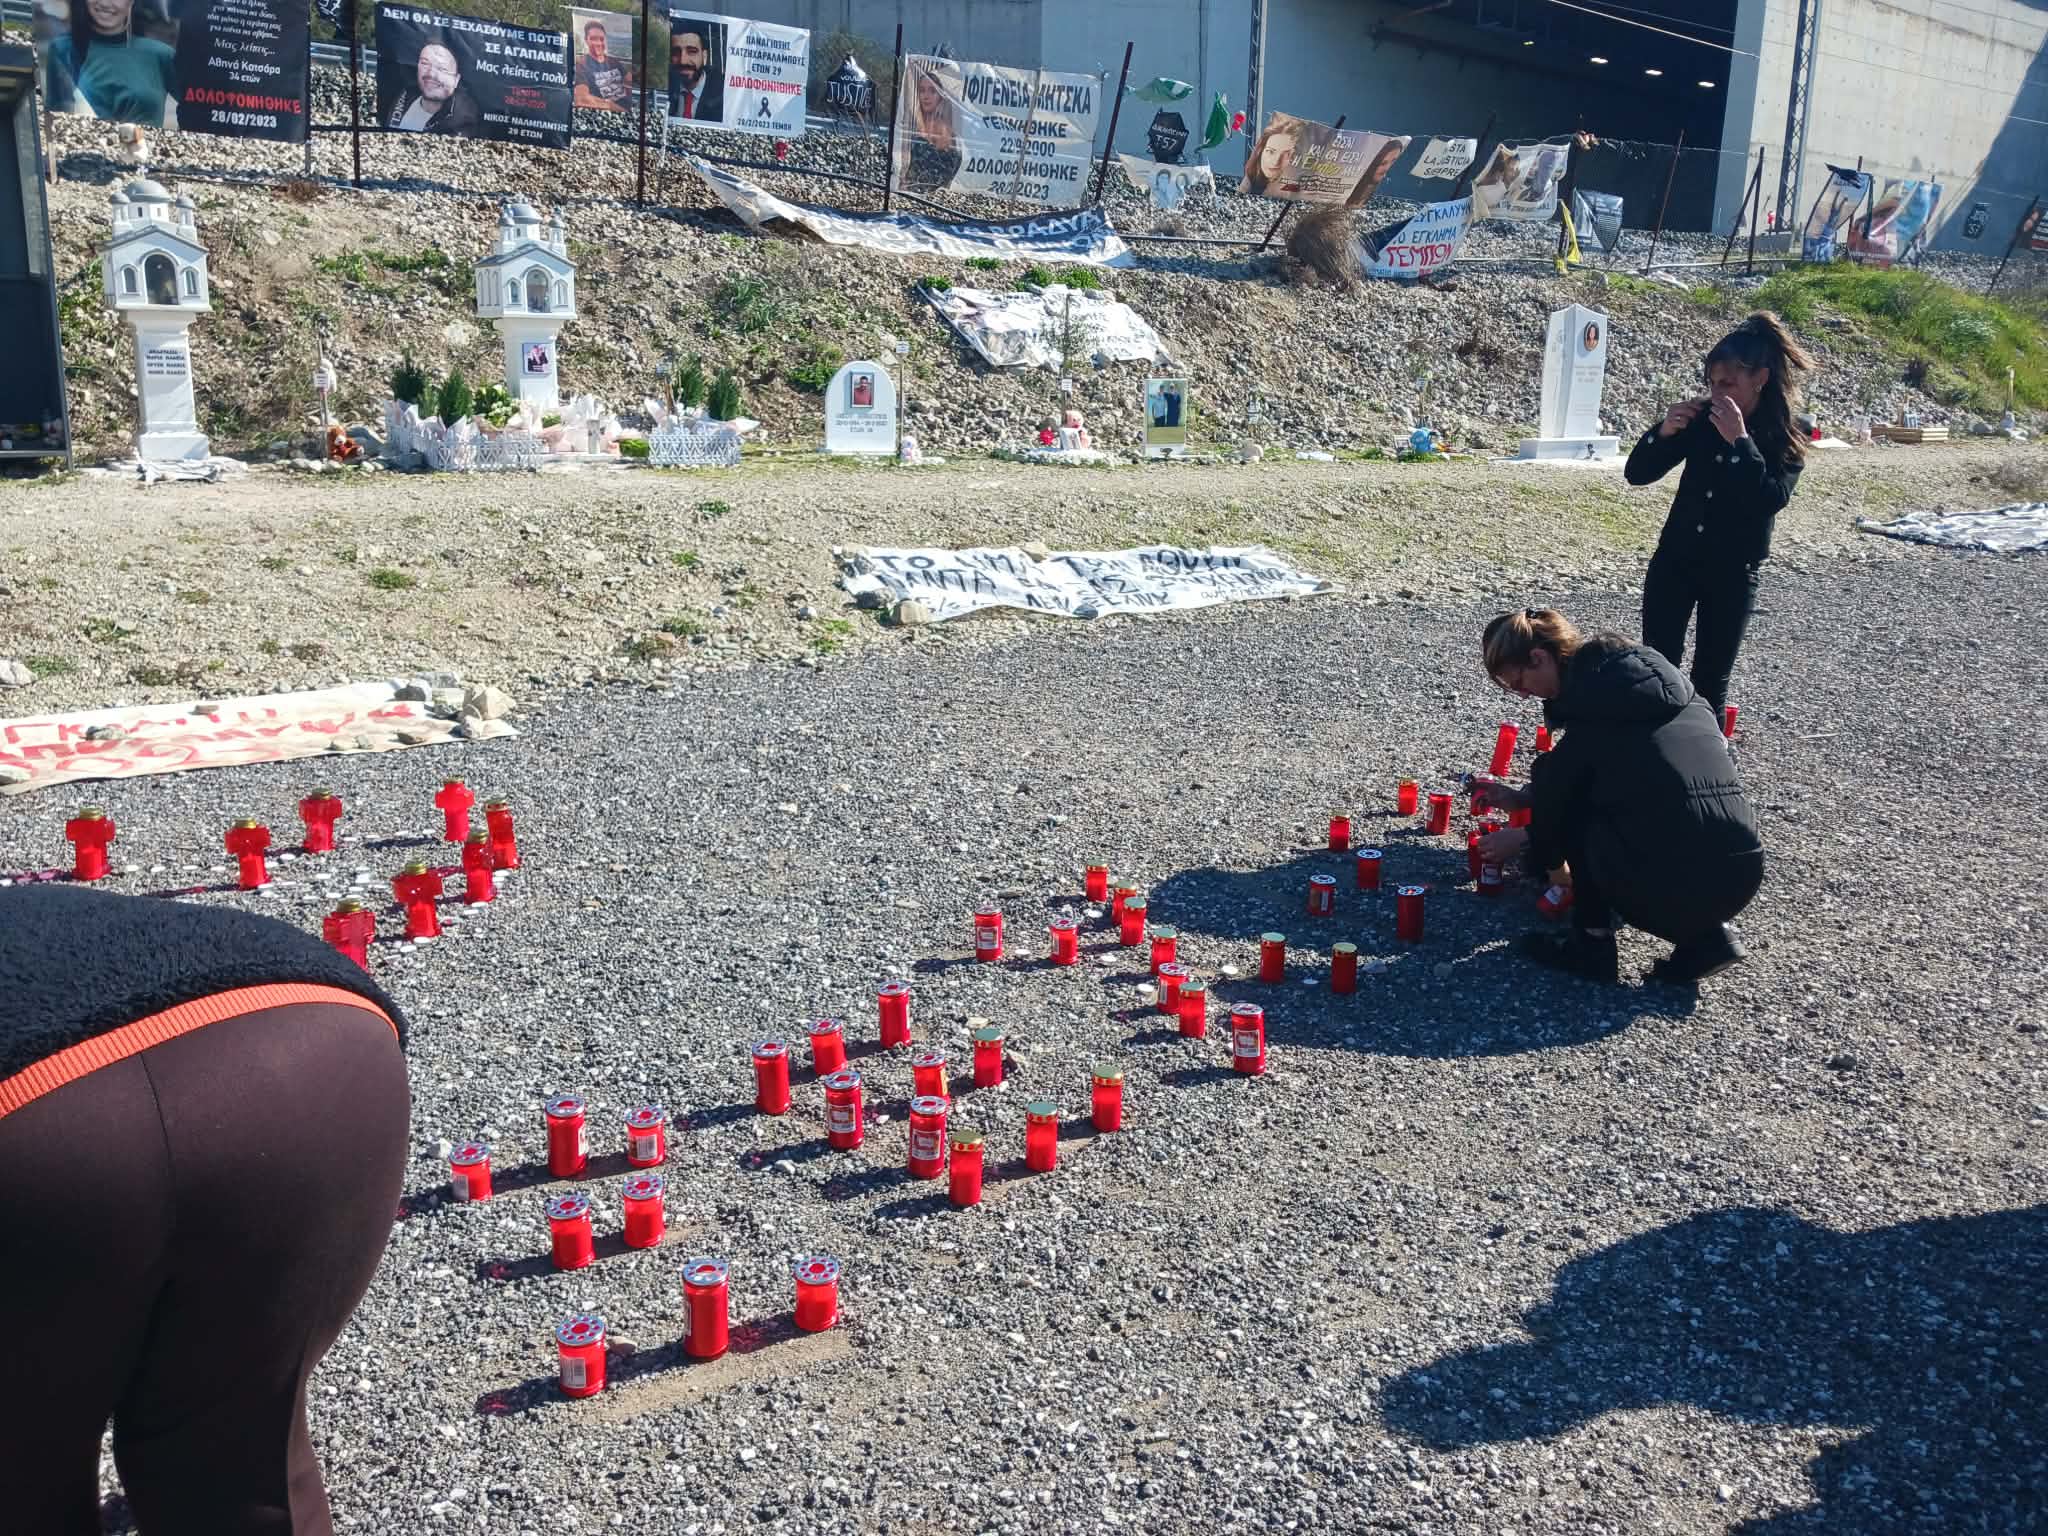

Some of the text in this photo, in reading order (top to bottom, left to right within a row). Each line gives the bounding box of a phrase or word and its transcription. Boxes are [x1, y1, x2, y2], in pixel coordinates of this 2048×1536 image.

[383, 7, 409, 21] ΔΕΝ
[412, 12, 431, 25] ΘΑ
[433, 15, 450, 28] ΣΕ
[451, 18, 525, 41] ΞΕΧΑΣΟΥΜΕ
[214, 38, 237, 53] Μας
[485, 41, 564, 65] ΣΕ ΑΓΑΠΑΜΕ
[208, 56, 239, 71] Αθηνά
[730, 46, 806, 67] ΧΑΤΖΗΧΑΡΑΛΑΜΠΟΥΣ
[229, 71, 240, 81] 34
[476, 59, 568, 85] Μας λείπεις πολύ
[752, 62, 782, 77] ΕΤΩΝ 29
[729, 74, 803, 97] ΔΟΛΟΦΟΝΗΘΗΚΕ
[961, 75, 1030, 109] ΙΦΙΓΕΝΕΙΑ
[184, 87, 302, 115] ΔΟΛΟΦΟΝΗΘΗΚΕ
[211, 109, 277, 129] 28/02/2023
[483, 112, 569, 132] ΝΙΚΟΣ ΝΑΛΜΠΑΝΤΗΣ
[520, 129, 543, 140] ΕΤΩΝ
[1413, 227, 1457, 244] ΕΓΚΛΗΜΑ
[871, 555, 935, 571] ΤΟ
